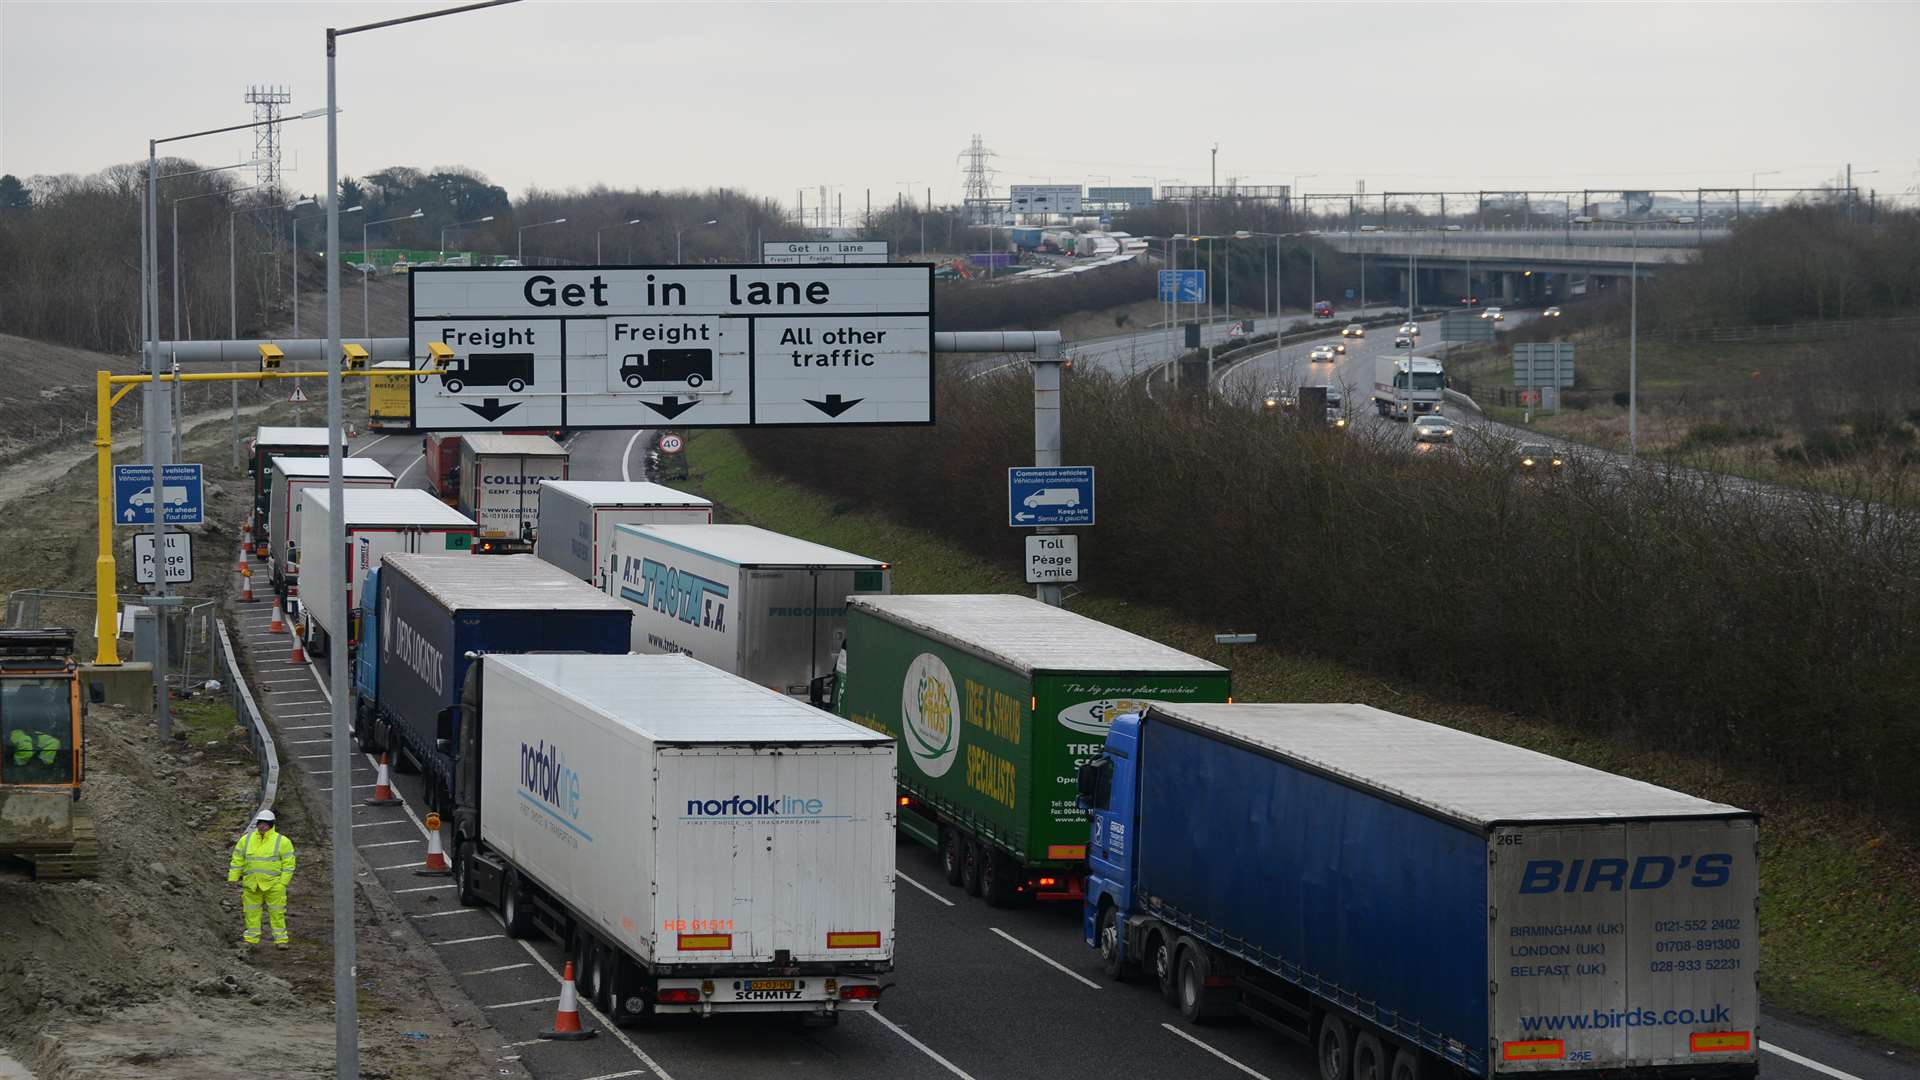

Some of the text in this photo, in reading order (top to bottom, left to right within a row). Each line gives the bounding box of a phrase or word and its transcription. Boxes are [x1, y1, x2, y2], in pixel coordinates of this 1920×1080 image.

[789, 243, 864, 253] Get in lane
[523, 273, 831, 308] Get in lane
[441, 327, 536, 349] Freight
[614, 322, 710, 345] Freight
[779, 327, 887, 346] All other
[791, 348, 875, 368] traffic
[664, 439, 679, 448] 40
[1015, 469, 1057, 477] Commercial
[175, 506, 197, 514] ahead
[148, 538, 176, 548] Tll
[1038, 539, 1064, 549] Toll
[142, 554, 185, 565] Pge
[1032, 554, 1072, 566] Péage
[1044, 567, 1073, 577] mile
[623, 556, 641, 586] A.T.
[703, 598, 727, 633] S.A.
[648, 632, 693, 658] www.trotacom
[396, 617, 443, 697] DFDS LOGISTICS
[1103, 686, 1131, 696] green
[1131, 684, 1157, 696] plant
[965, 679, 984, 728] TREE
[993, 690, 1021, 745] SHRUB
[1066, 743, 1105, 755] TRE
[520, 739, 580, 820] norfolkline
[966, 743, 1016, 810] SPECIALISTS
[687, 795, 824, 816] norfolkline
[1497, 834, 1522, 846] 26E
[1518, 853, 1733, 894] BIRD'S
[664, 918, 737, 931] HB 61511
[1510, 923, 1625, 938] BIRMINGHAM (UK)
[1655, 918, 1740, 932] 0121-552 2402
[1511, 943, 1606, 957] LONDON (UK)
[1655, 939, 1740, 952] 01708-891300
[1511, 964, 1606, 977] BELFAST (UK)
[1650, 959, 1741, 972] 028-933 52231
[735, 991, 803, 1000] SCHMITZ
[1520, 1004, 1731, 1031] www.birds.co.uk
[1570, 1050, 1593, 1062] 26E
